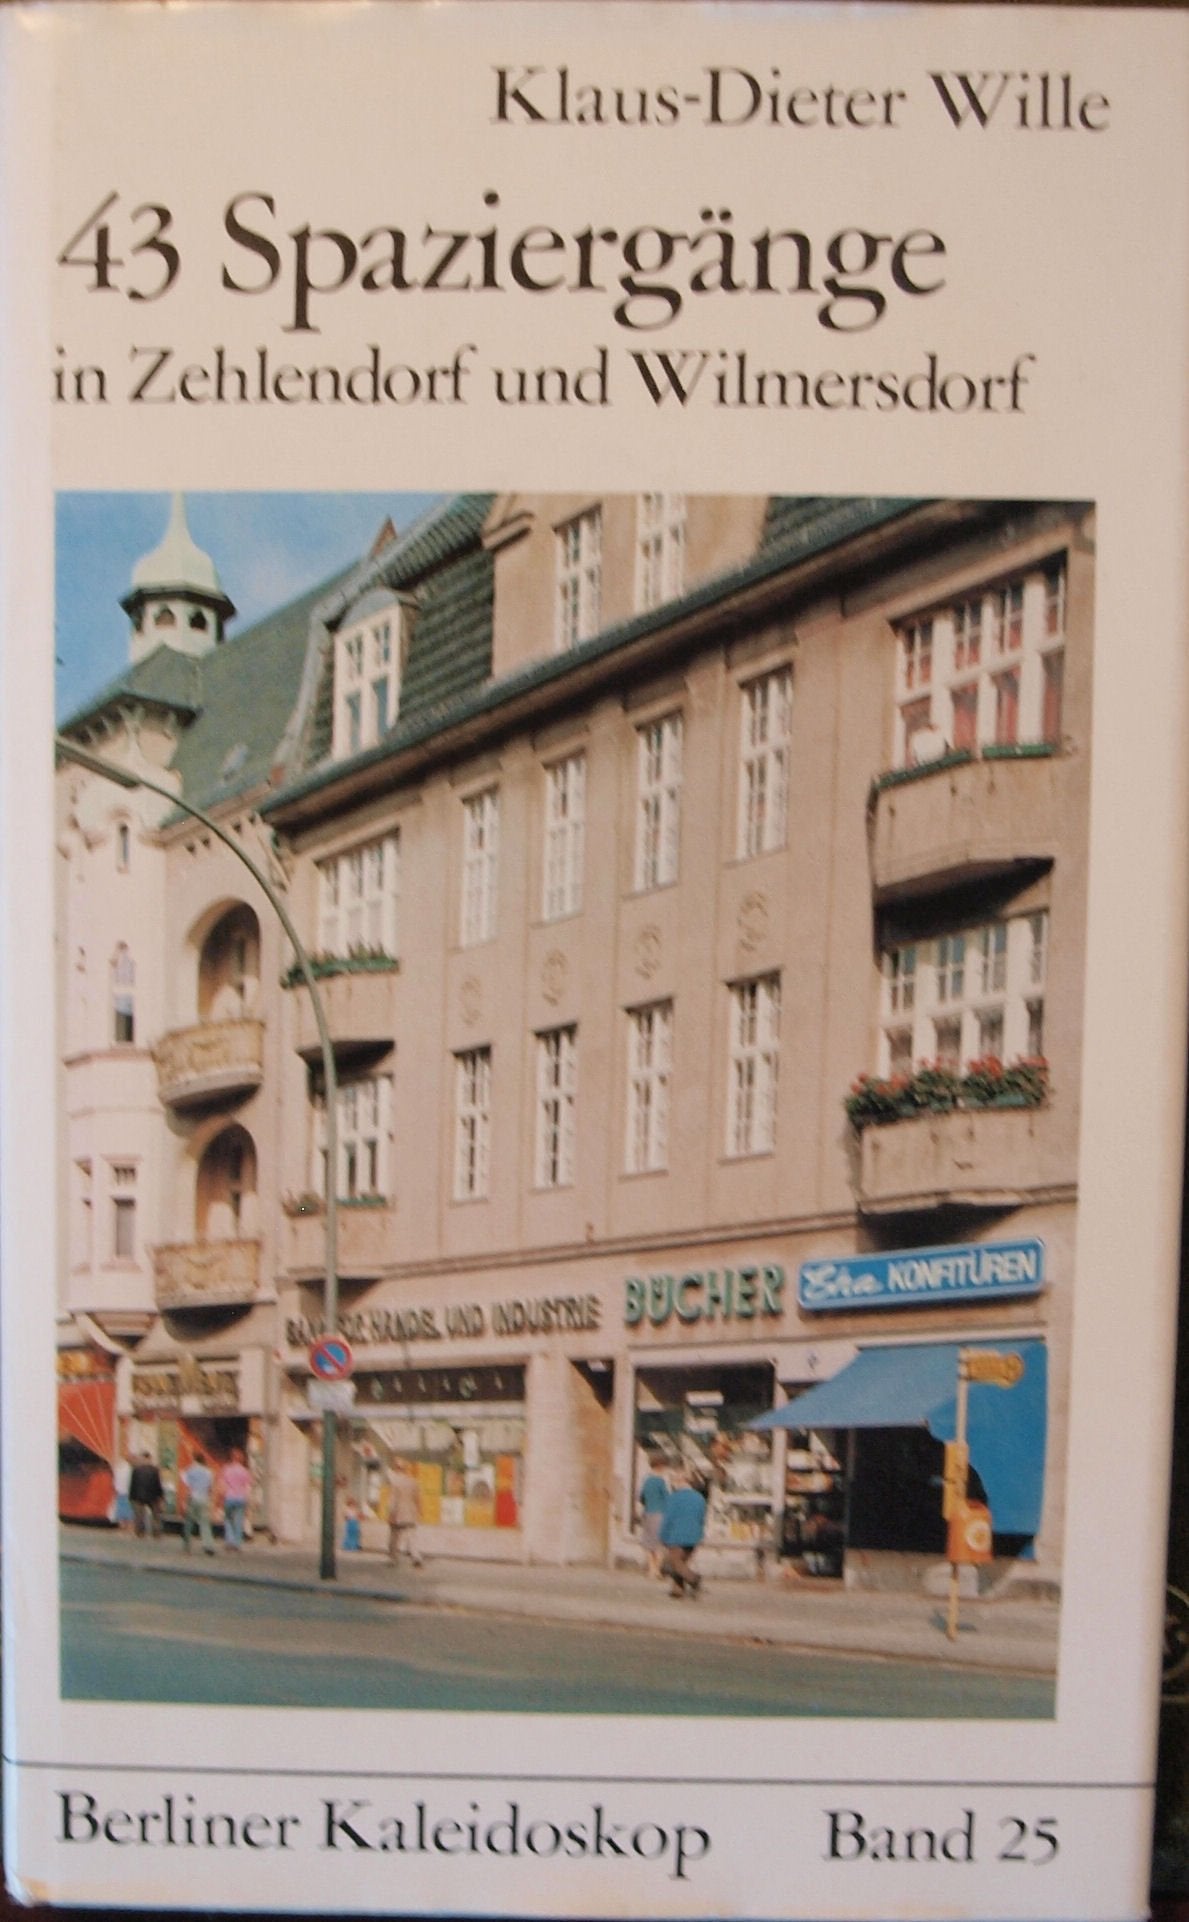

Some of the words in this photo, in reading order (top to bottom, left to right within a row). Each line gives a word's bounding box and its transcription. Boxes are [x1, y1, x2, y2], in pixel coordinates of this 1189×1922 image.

[497, 67, 906, 128] Klaus-Dieter
[929, 72, 1109, 131] Wille
[59, 189, 180, 302] 43
[222, 189, 948, 332] Spaziergänge
[54, 347, 106, 403] in
[130, 345, 478, 404] Zehlendorf
[495, 348, 607, 405] und
[631, 351, 1036, 411] Wilmersdorf
[624, 1265, 784, 1325] BÜCHER
[886, 1248, 1037, 1294] KONFITÜREN
[60, 1792, 301, 1850] Berliner
[324, 1801, 712, 1880] Kaleidoskop
[826, 1809, 974, 1862] Band
[998, 1817, 1059, 1861] 25
